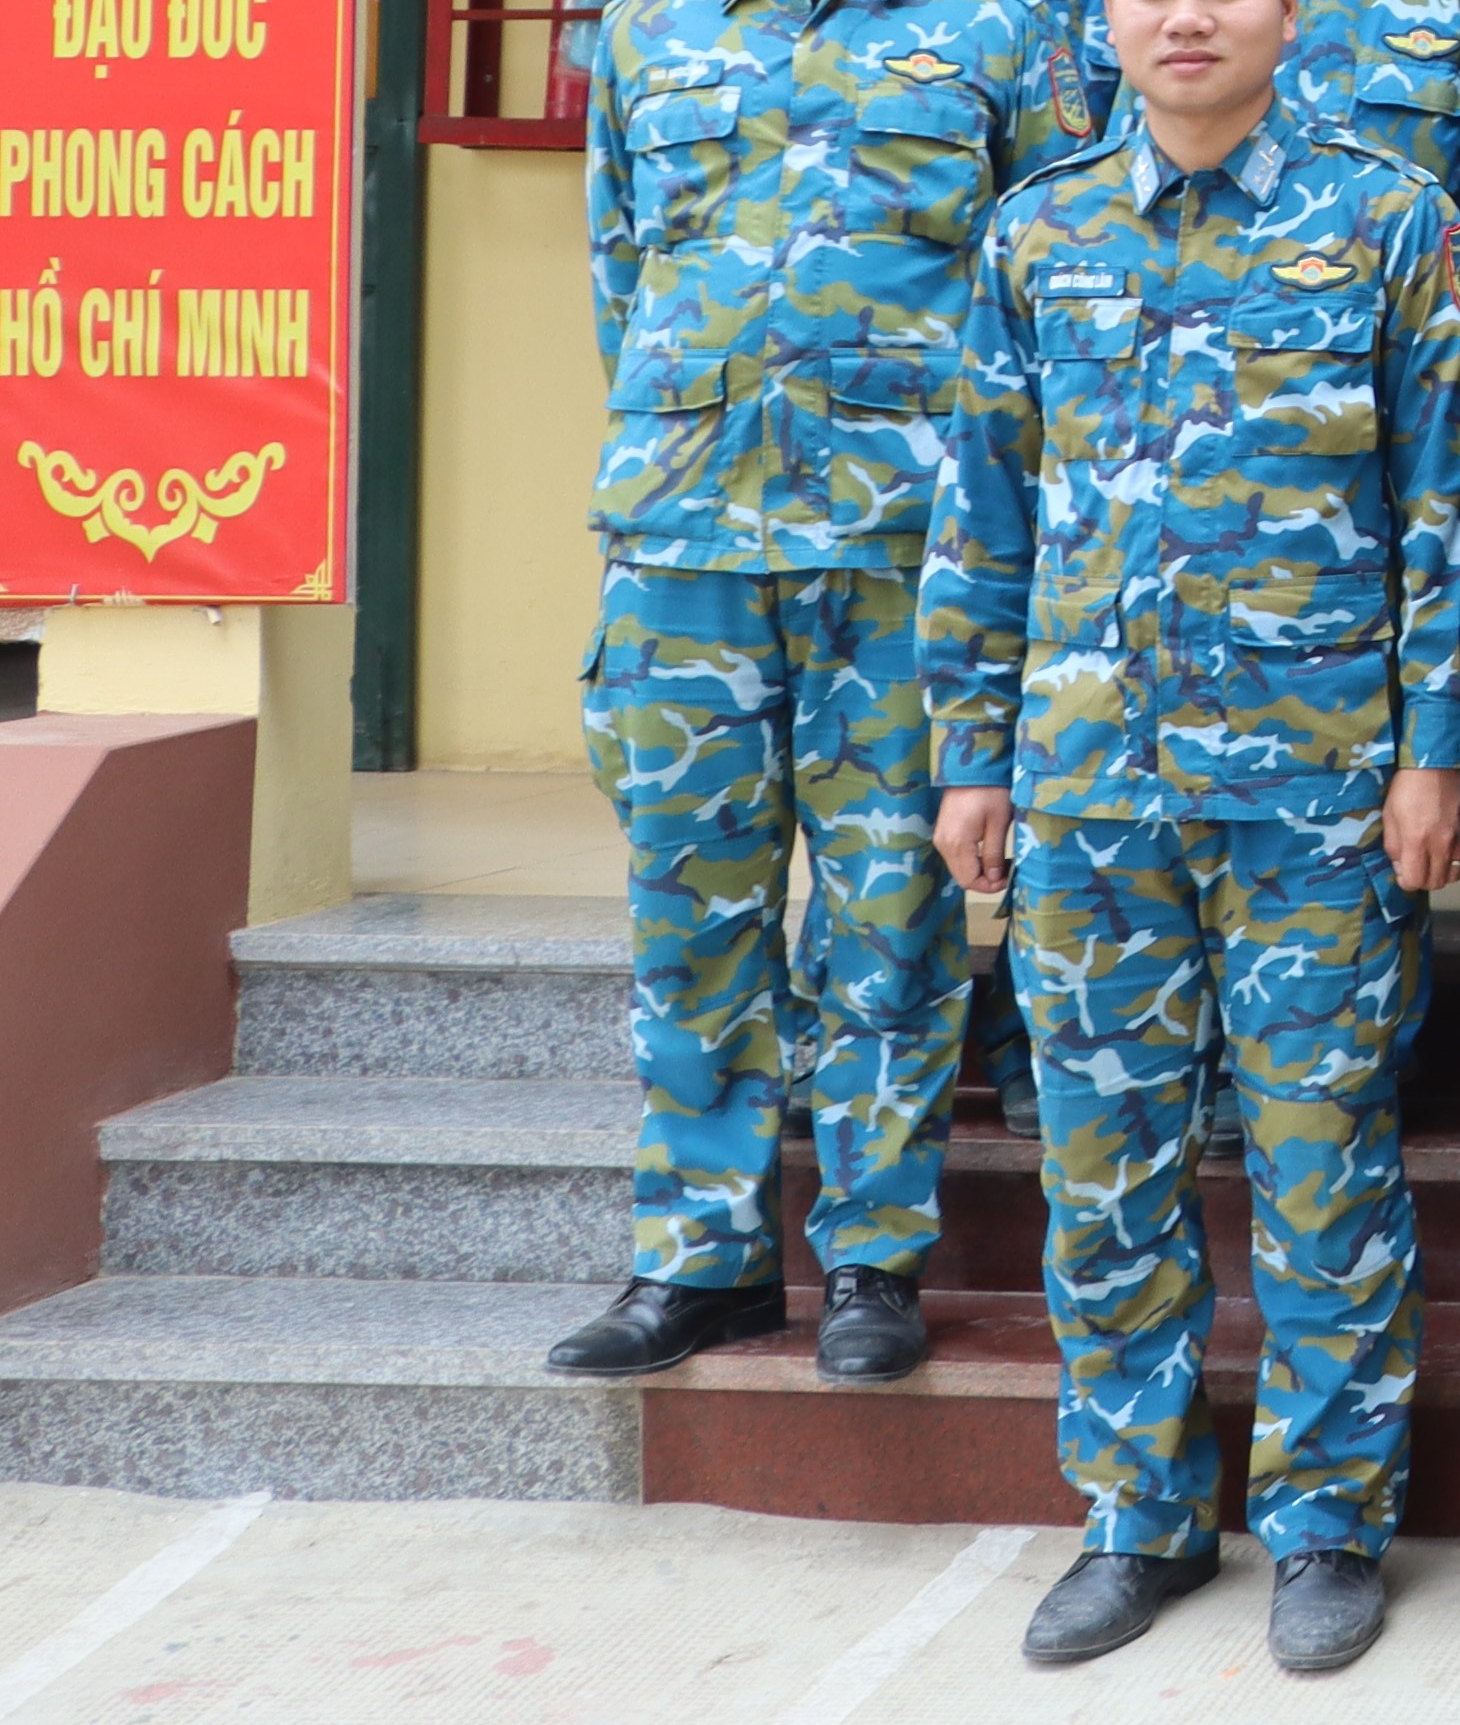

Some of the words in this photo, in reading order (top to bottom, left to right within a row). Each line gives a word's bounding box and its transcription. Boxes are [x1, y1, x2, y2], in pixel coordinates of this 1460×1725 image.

[0, 128, 166, 218] PHONG
[181, 109, 315, 219] CÁCH
[0, 257, 64, 378] HỒ
[78, 269, 162, 379] CHÍ
[176, 289, 309, 378] MINH
